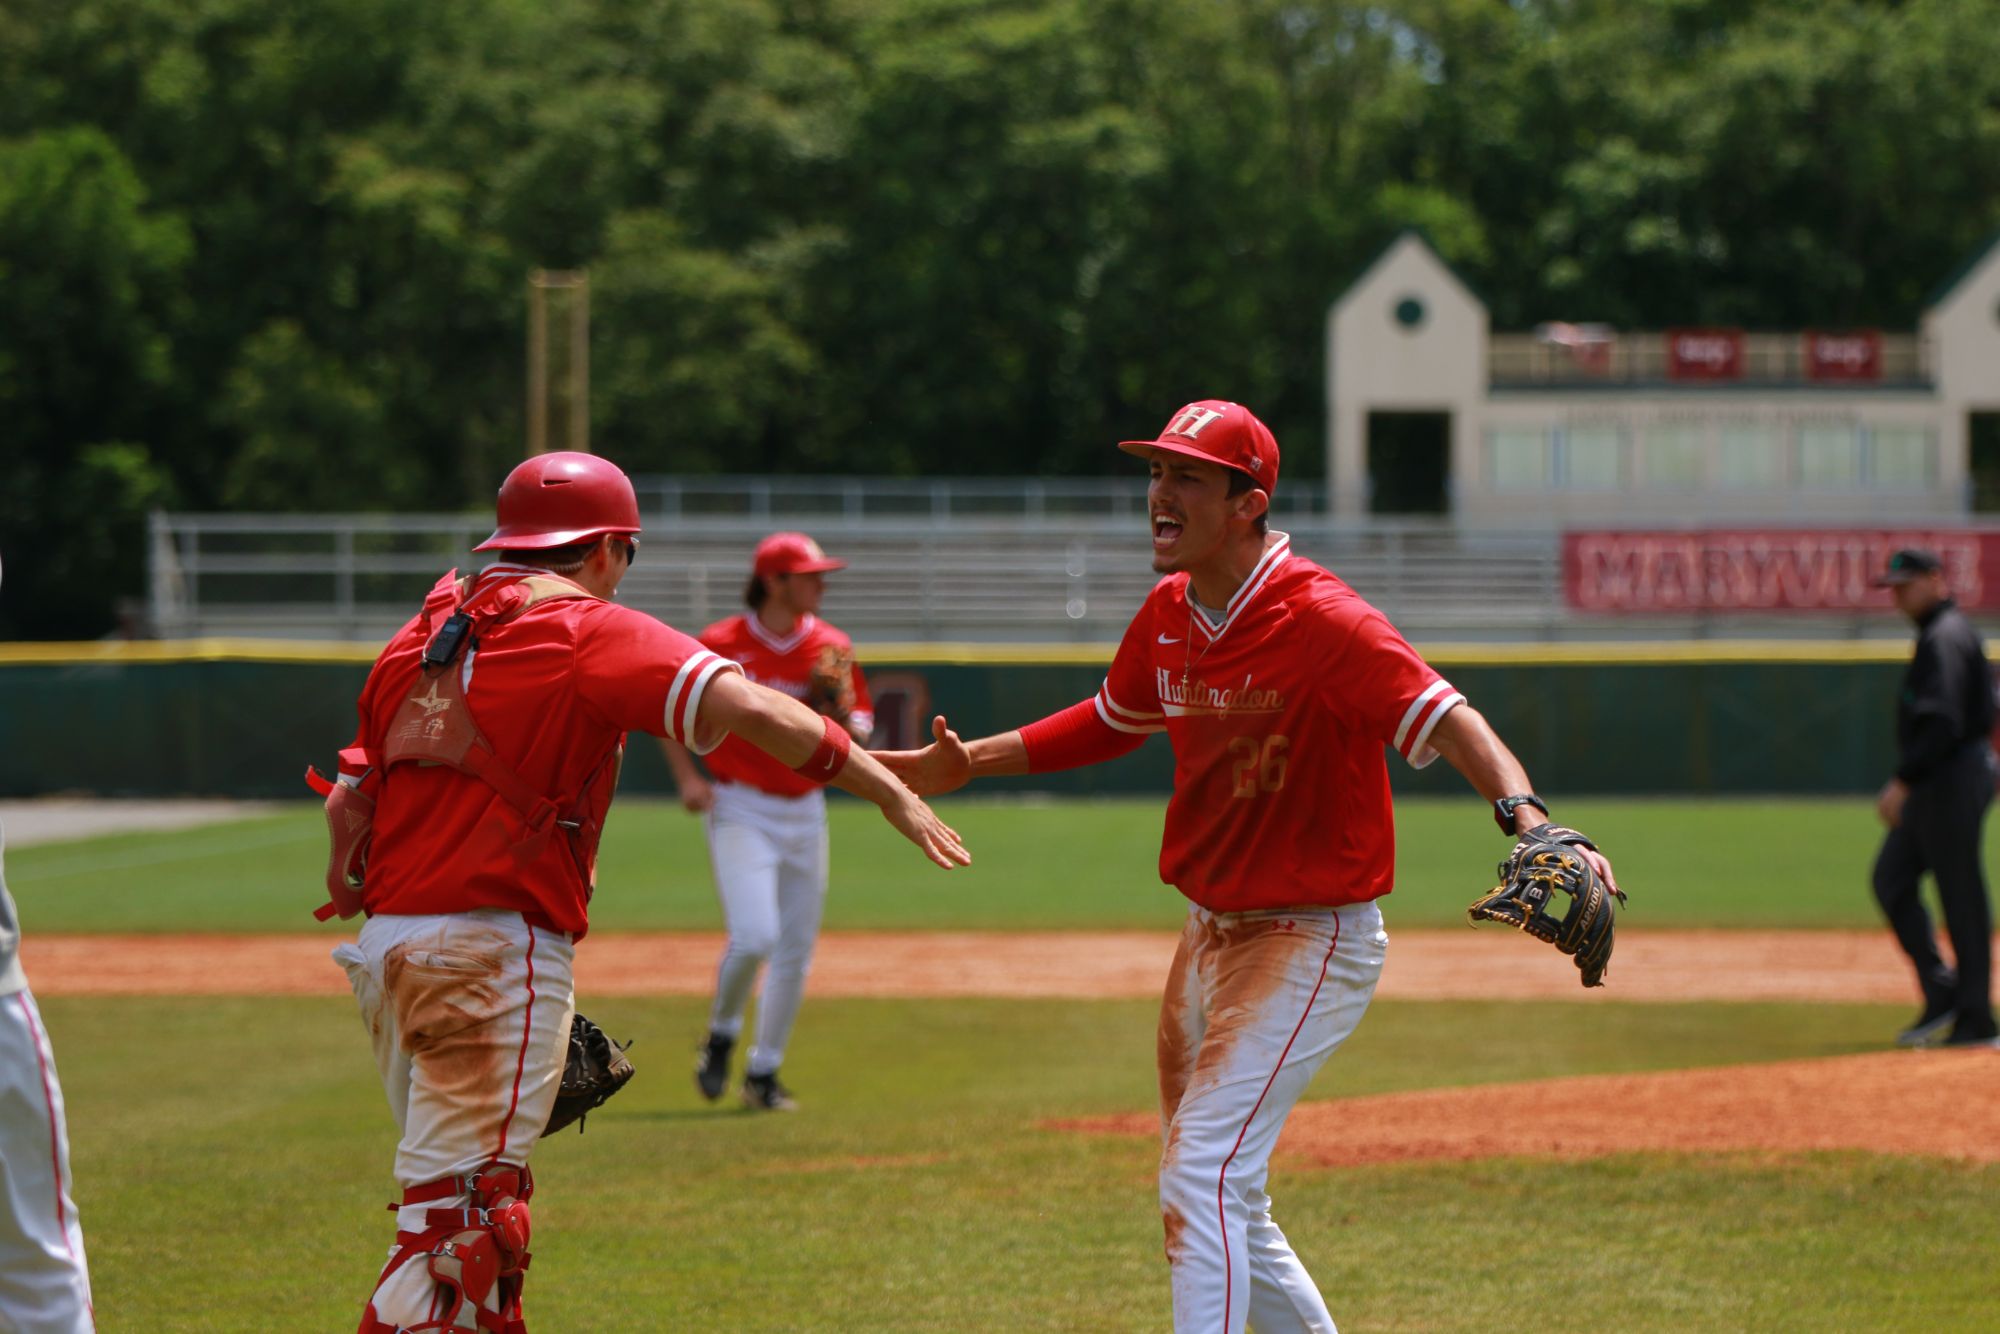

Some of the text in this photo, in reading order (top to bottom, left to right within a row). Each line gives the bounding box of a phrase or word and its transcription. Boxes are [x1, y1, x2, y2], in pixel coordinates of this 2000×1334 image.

[1165, 406, 1224, 439] H
[1156, 667, 1284, 720] Huntingdon
[1228, 734, 1289, 798] 26
[1580, 886, 1600, 930] A2000
